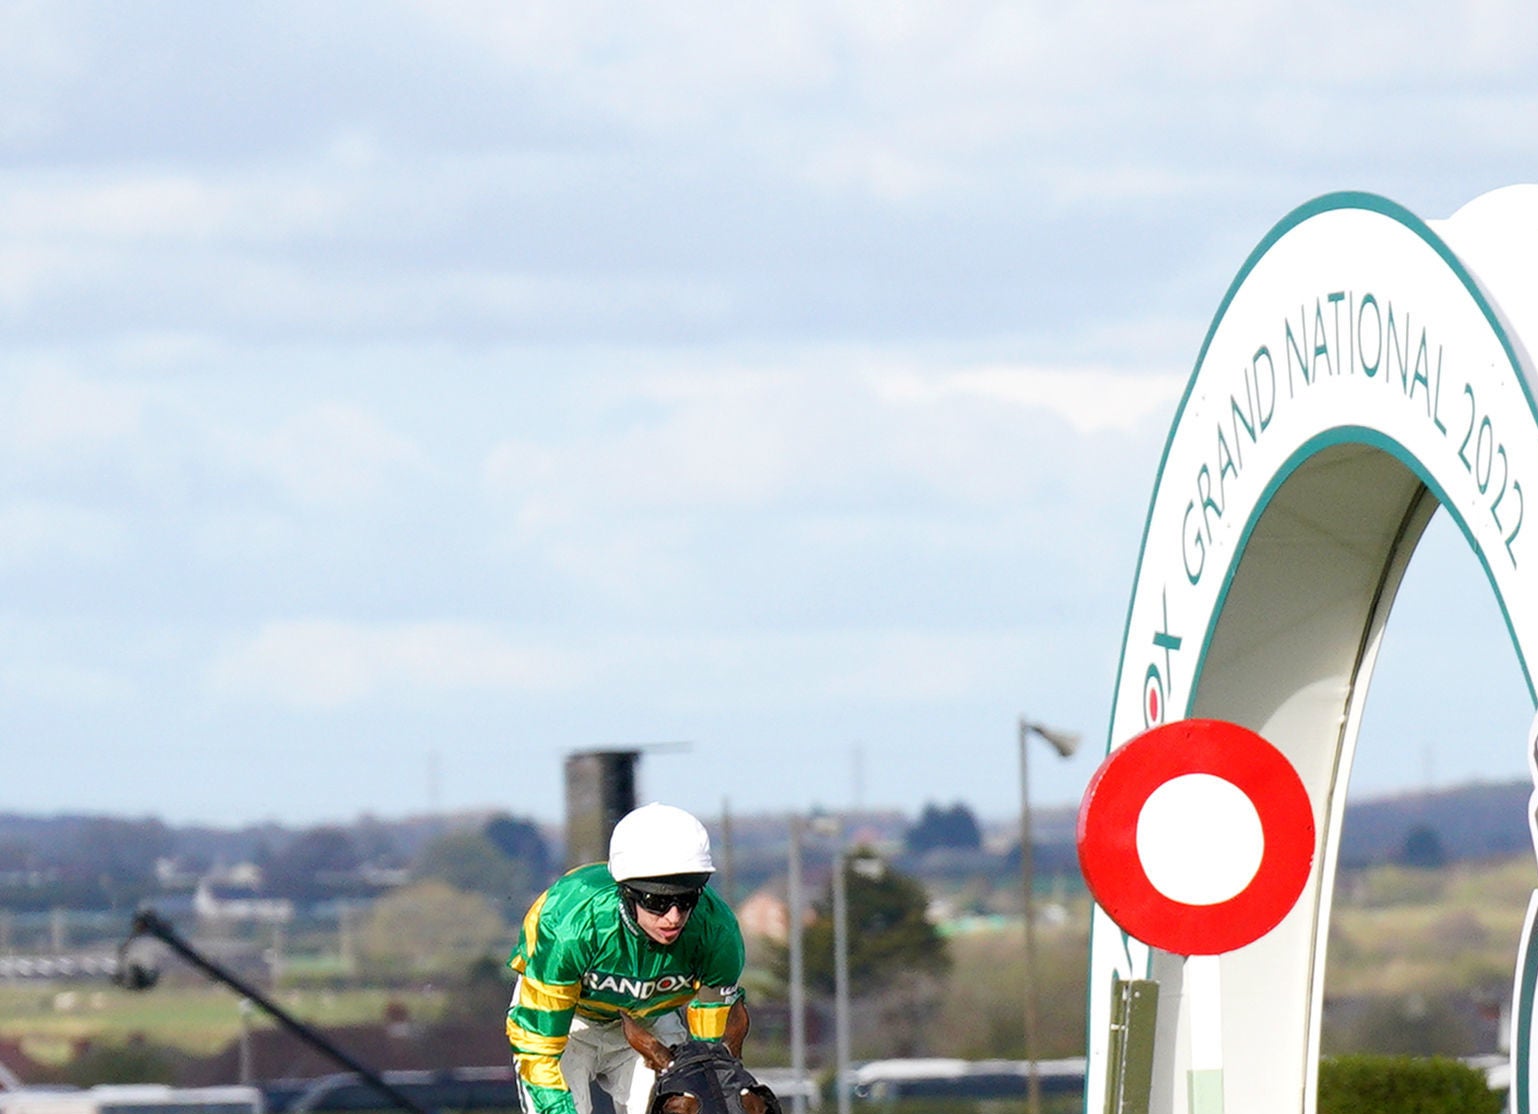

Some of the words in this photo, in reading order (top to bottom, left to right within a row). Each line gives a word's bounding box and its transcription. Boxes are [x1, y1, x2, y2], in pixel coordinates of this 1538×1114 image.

[1182, 345, 1276, 586] GRAND
[1285, 290, 1447, 437] NATIONAL
[1458, 382, 1524, 571] 2022
[583, 971, 695, 1000] RANDOX
